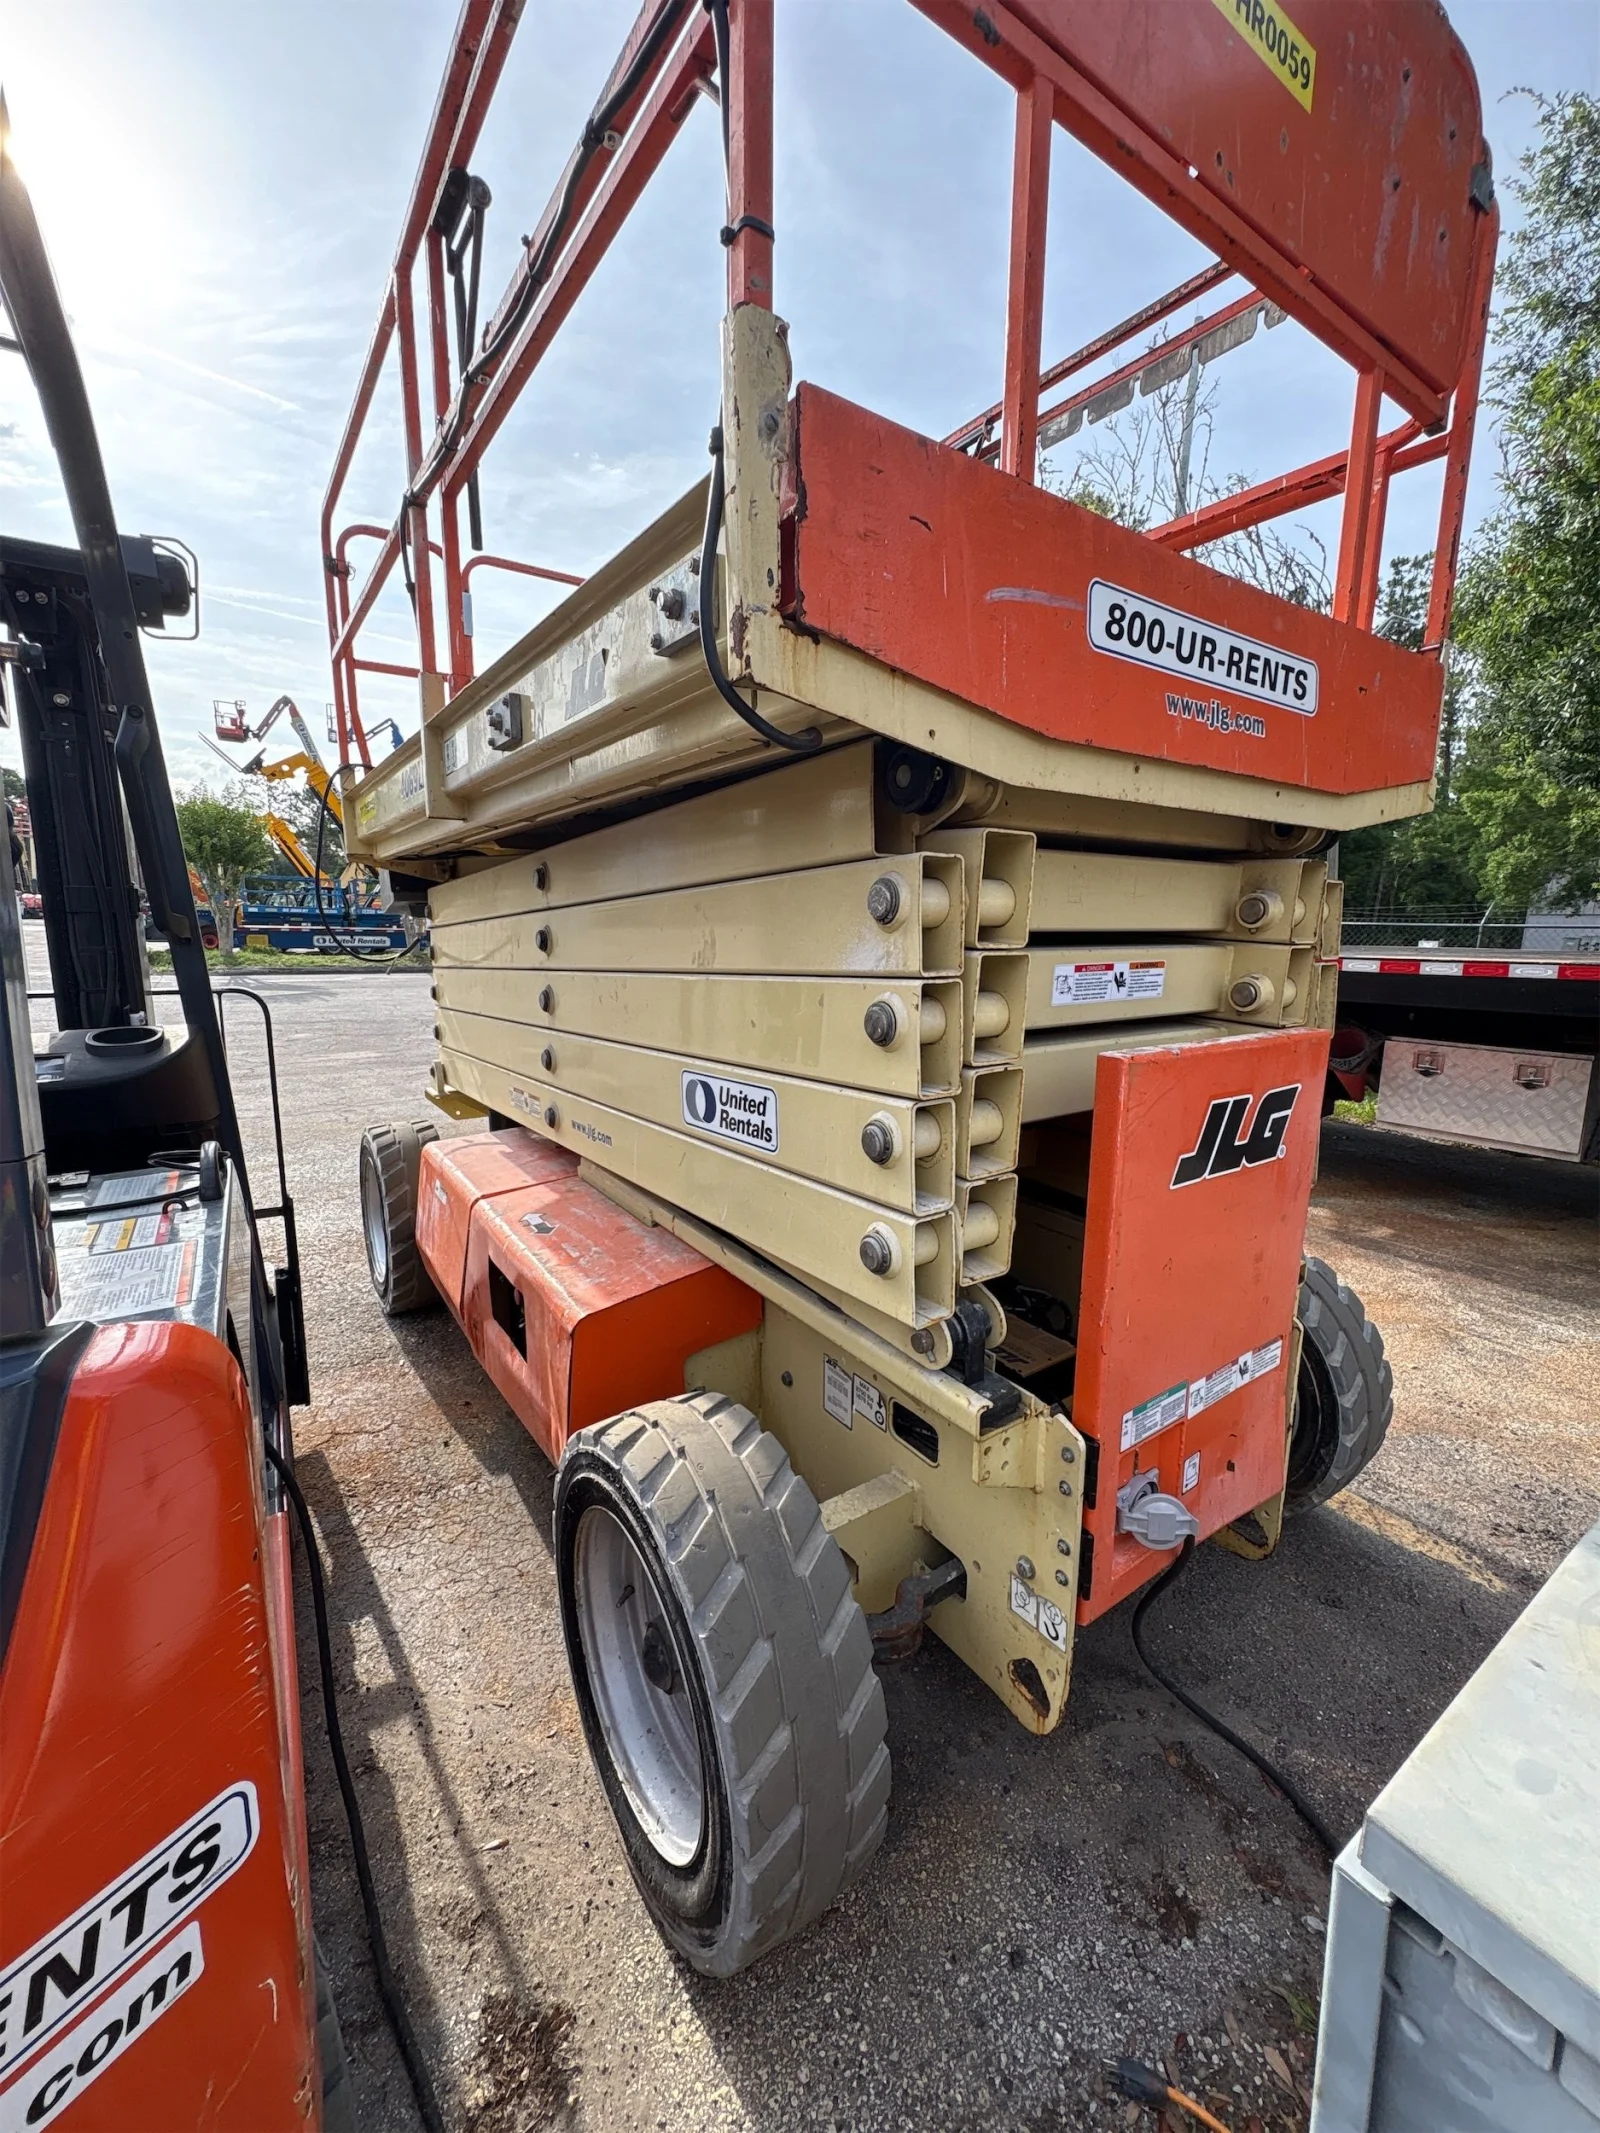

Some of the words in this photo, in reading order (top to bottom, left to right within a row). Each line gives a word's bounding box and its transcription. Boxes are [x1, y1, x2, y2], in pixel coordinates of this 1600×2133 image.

[1105, 603, 1308, 701] 800-UR-RENTS
[564, 648, 607, 721] JLG
[1166, 693, 1266, 737] www.jlg.com
[328, 936, 355, 945] Uited
[357, 937, 387, 945] Rentals
[719, 1085, 768, 1117] United
[571, 1119, 613, 1147] www.jlg.com
[719, 1108, 773, 1143] Rentals
[1171, 1084, 1301, 1188] JLG
